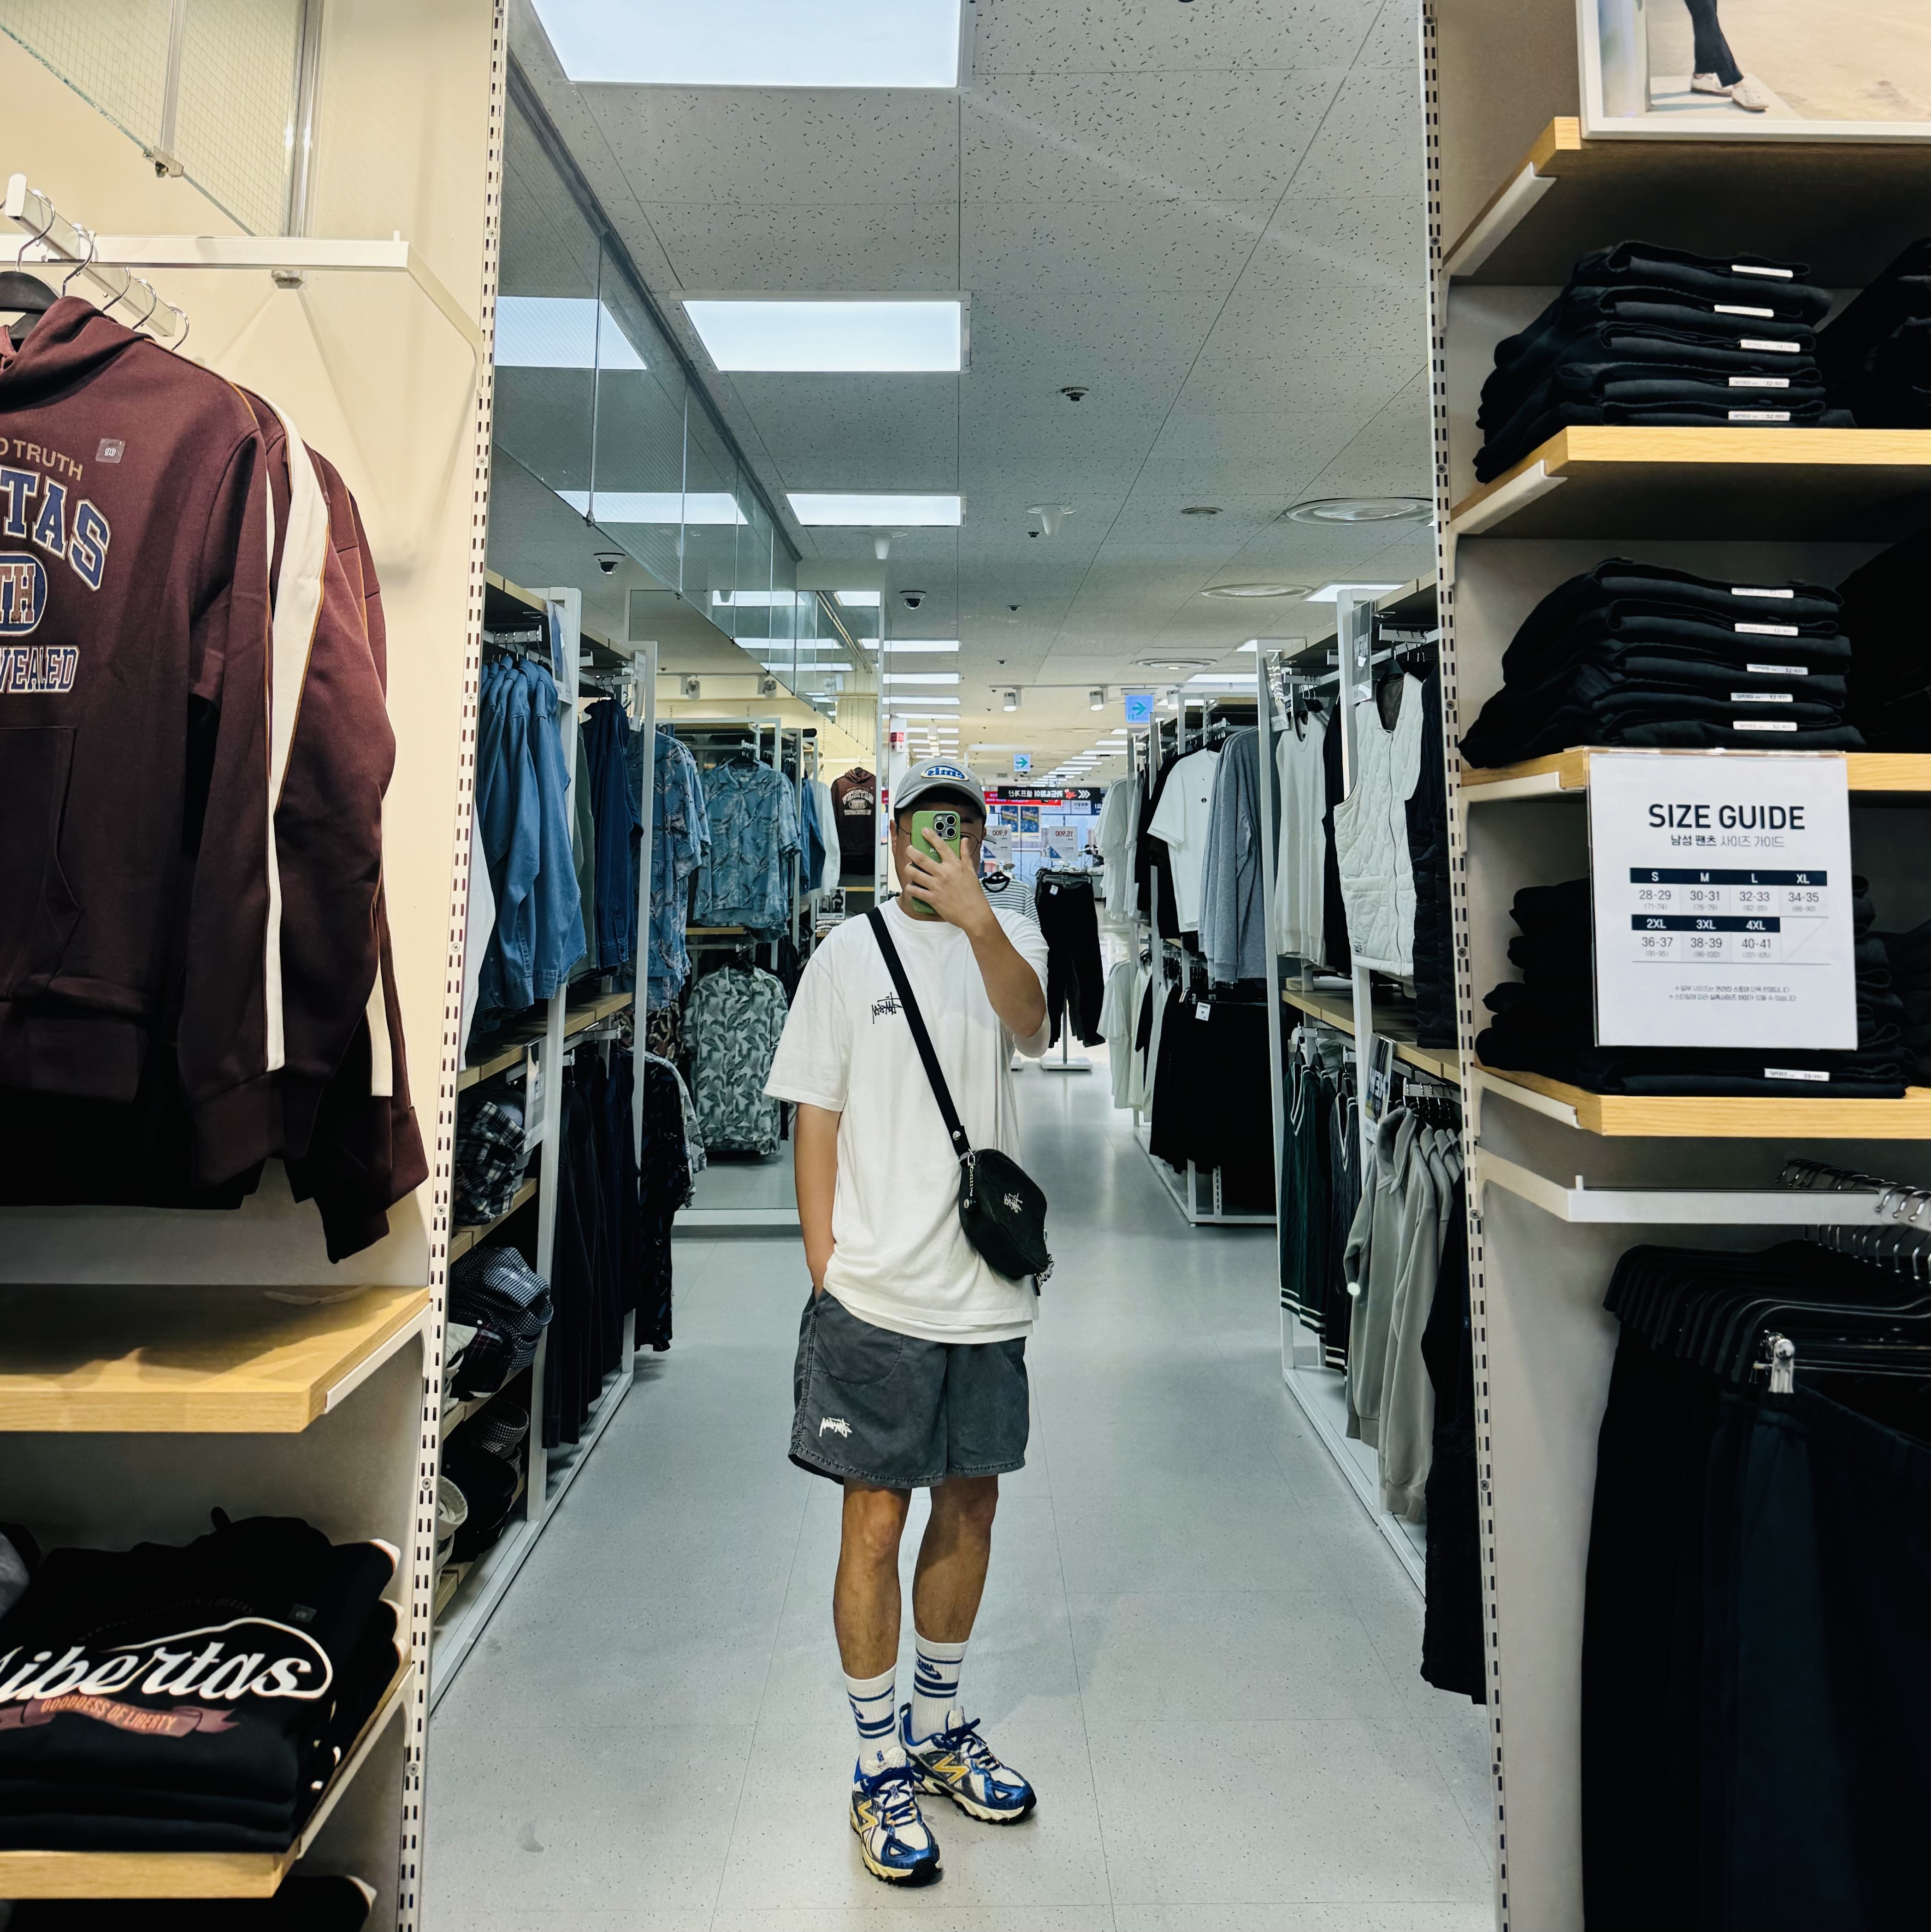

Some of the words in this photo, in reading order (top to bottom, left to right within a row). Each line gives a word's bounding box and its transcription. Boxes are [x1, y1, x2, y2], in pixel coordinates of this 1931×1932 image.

[13, 439, 83, 481] TRUTH
[1648, 804, 1711, 828] SIZE
[1718, 805, 1806, 830] GUIDE
[1671, 835, 1692, 846] 남성
[1695, 835, 1717, 846] 팬츠
[1720, 835, 1751, 847] 사이즈
[1754, 835, 1785, 847] 가이드
[1652, 872, 1659, 881] S
[1700, 872, 1709, 882] M
[1751, 873, 1758, 884] L
[1796, 873, 1810, 884] XL
[1639, 889, 1671, 901] 28-29
[1690, 890, 1720, 902] 30-31
[1739, 891, 1770, 903] 32-33
[1788, 892, 1819, 904] 34-35
[1647, 918, 1666, 929] 2XL
[1696, 919, 1716, 930] 3XL
[1746, 920, 1766, 930] 4XL
[1642, 937, 1673, 948] 36-37
[1690, 938, 1722, 949] 38-39
[1742, 938, 1771, 950] 40-41
[106, 1706, 127, 1721] OF
[123, 1711, 177, 1731] LIBERTY
